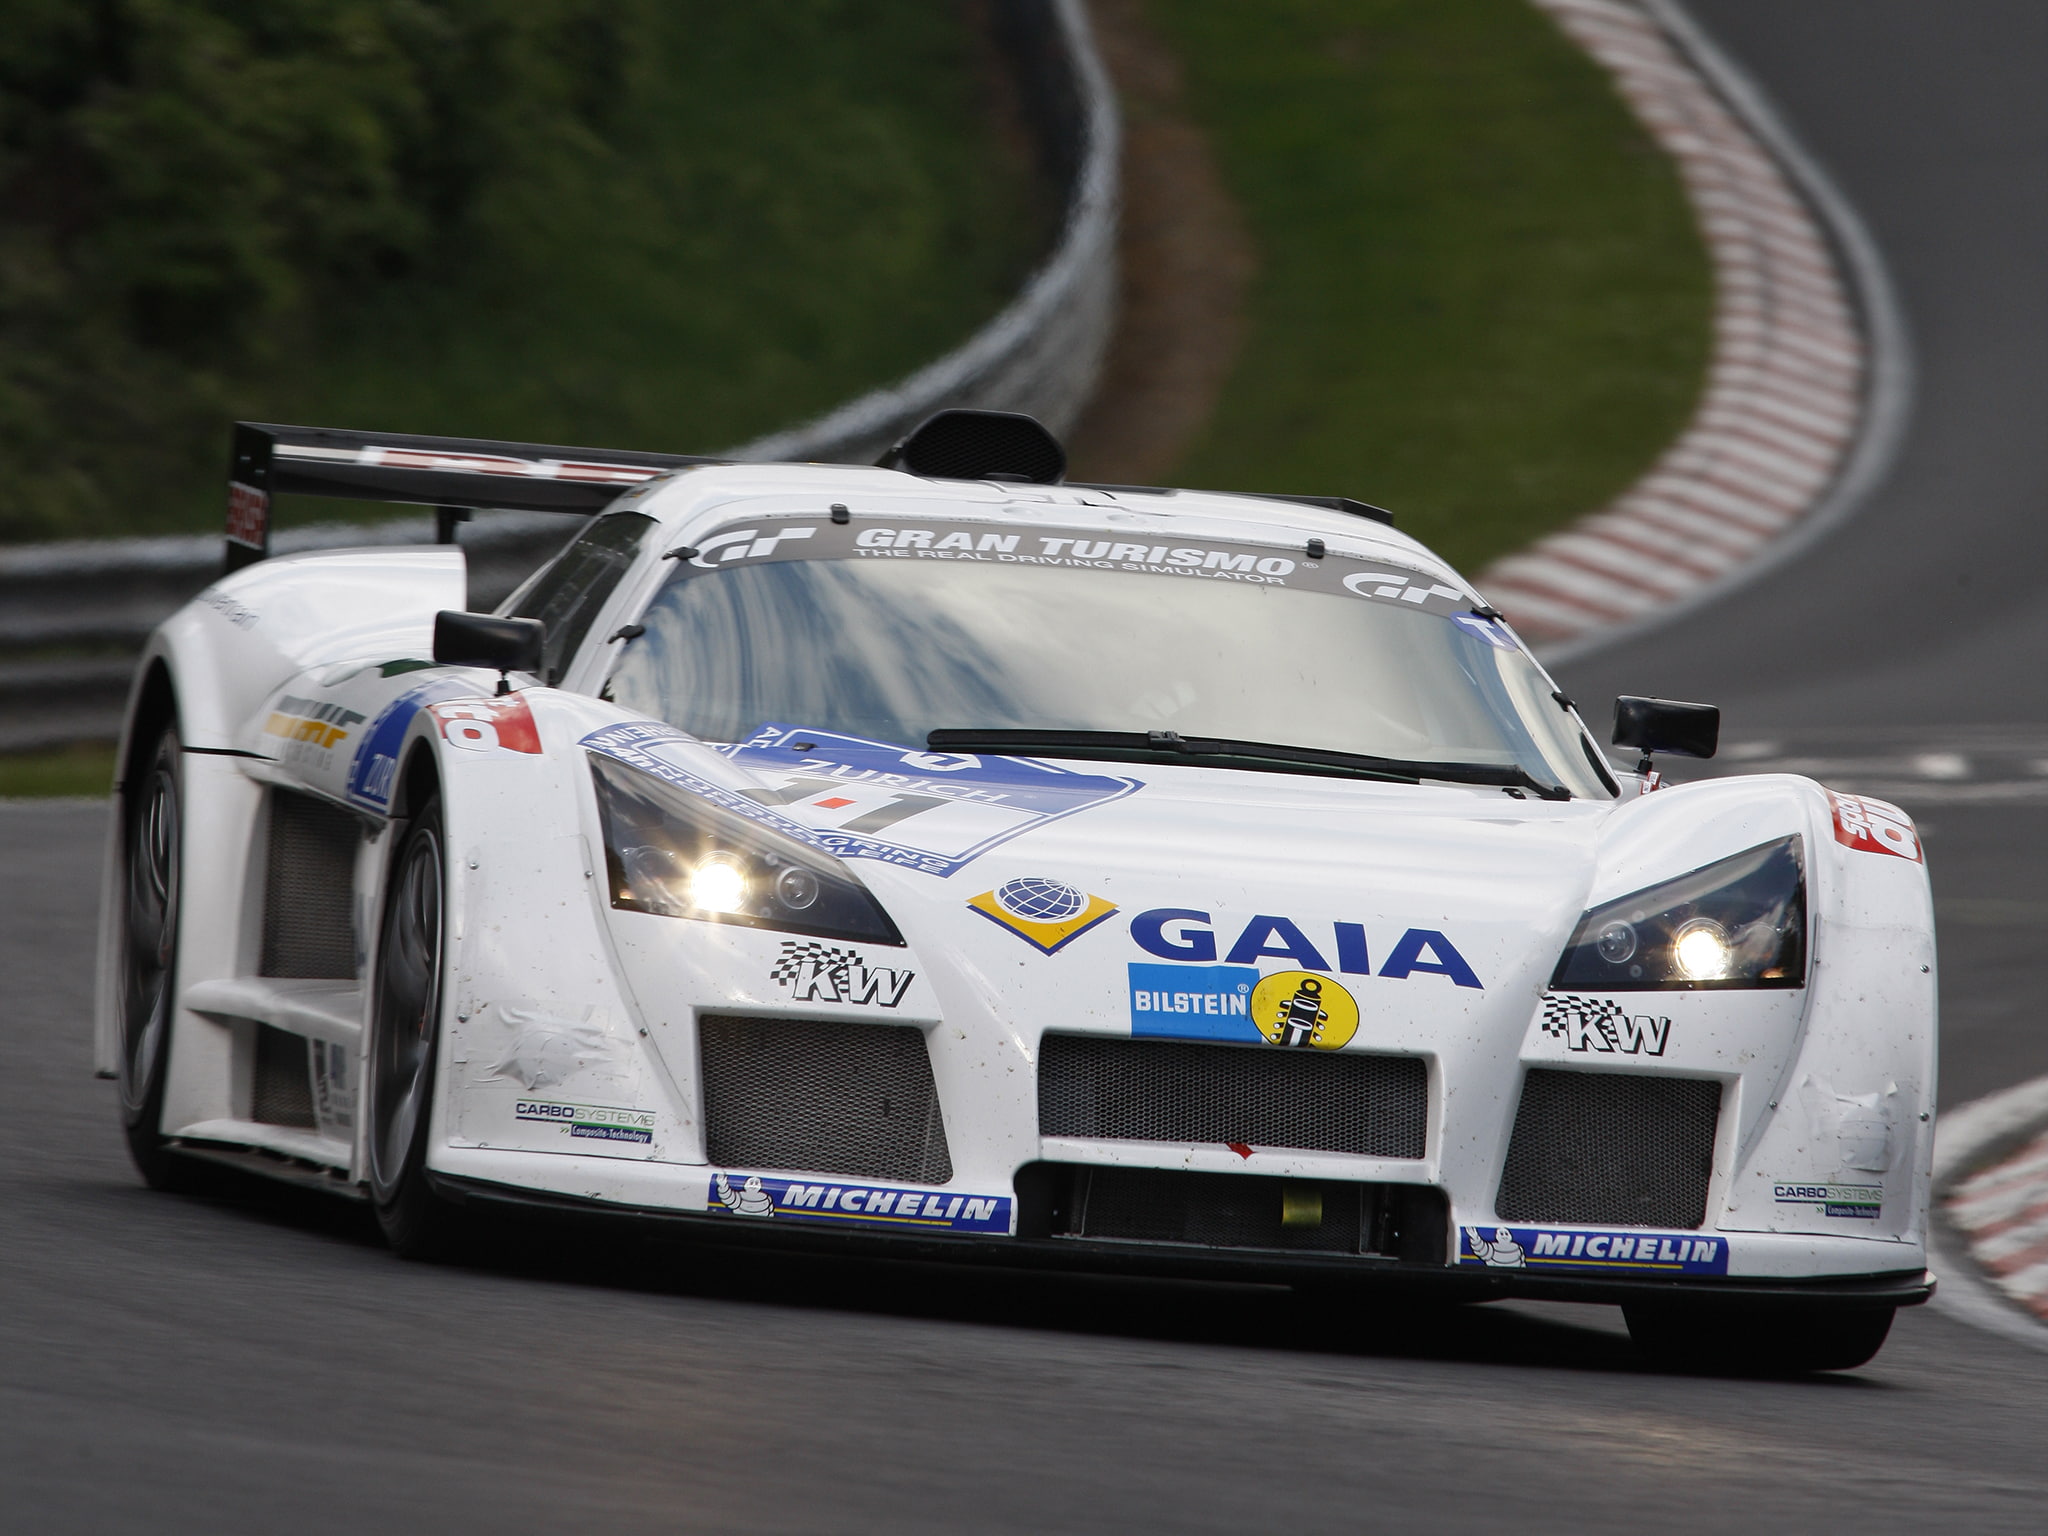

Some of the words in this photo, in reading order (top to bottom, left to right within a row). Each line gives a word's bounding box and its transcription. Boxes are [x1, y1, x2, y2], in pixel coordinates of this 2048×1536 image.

[852, 548, 910, 558] THE
[916, 550, 993, 561] REAL
[998, 553, 1114, 569] DRIVING
[1122, 562, 1286, 586] SIMULATOR
[855, 528, 1021, 552] GRAN
[1039, 537, 1296, 576] TURISMO
[786, 758, 1012, 803] ZURICH
[1130, 908, 1486, 990] GAIA
[793, 960, 917, 1008] KW
[1135, 991, 1247, 1016] BILSTEIN
[1566, 1011, 1671, 1056] KW
[516, 1103, 656, 1127] CARBOSYSTEMS
[782, 1184, 998, 1221] MICHELIN
[1532, 1233, 1718, 1263] MICHELIN
